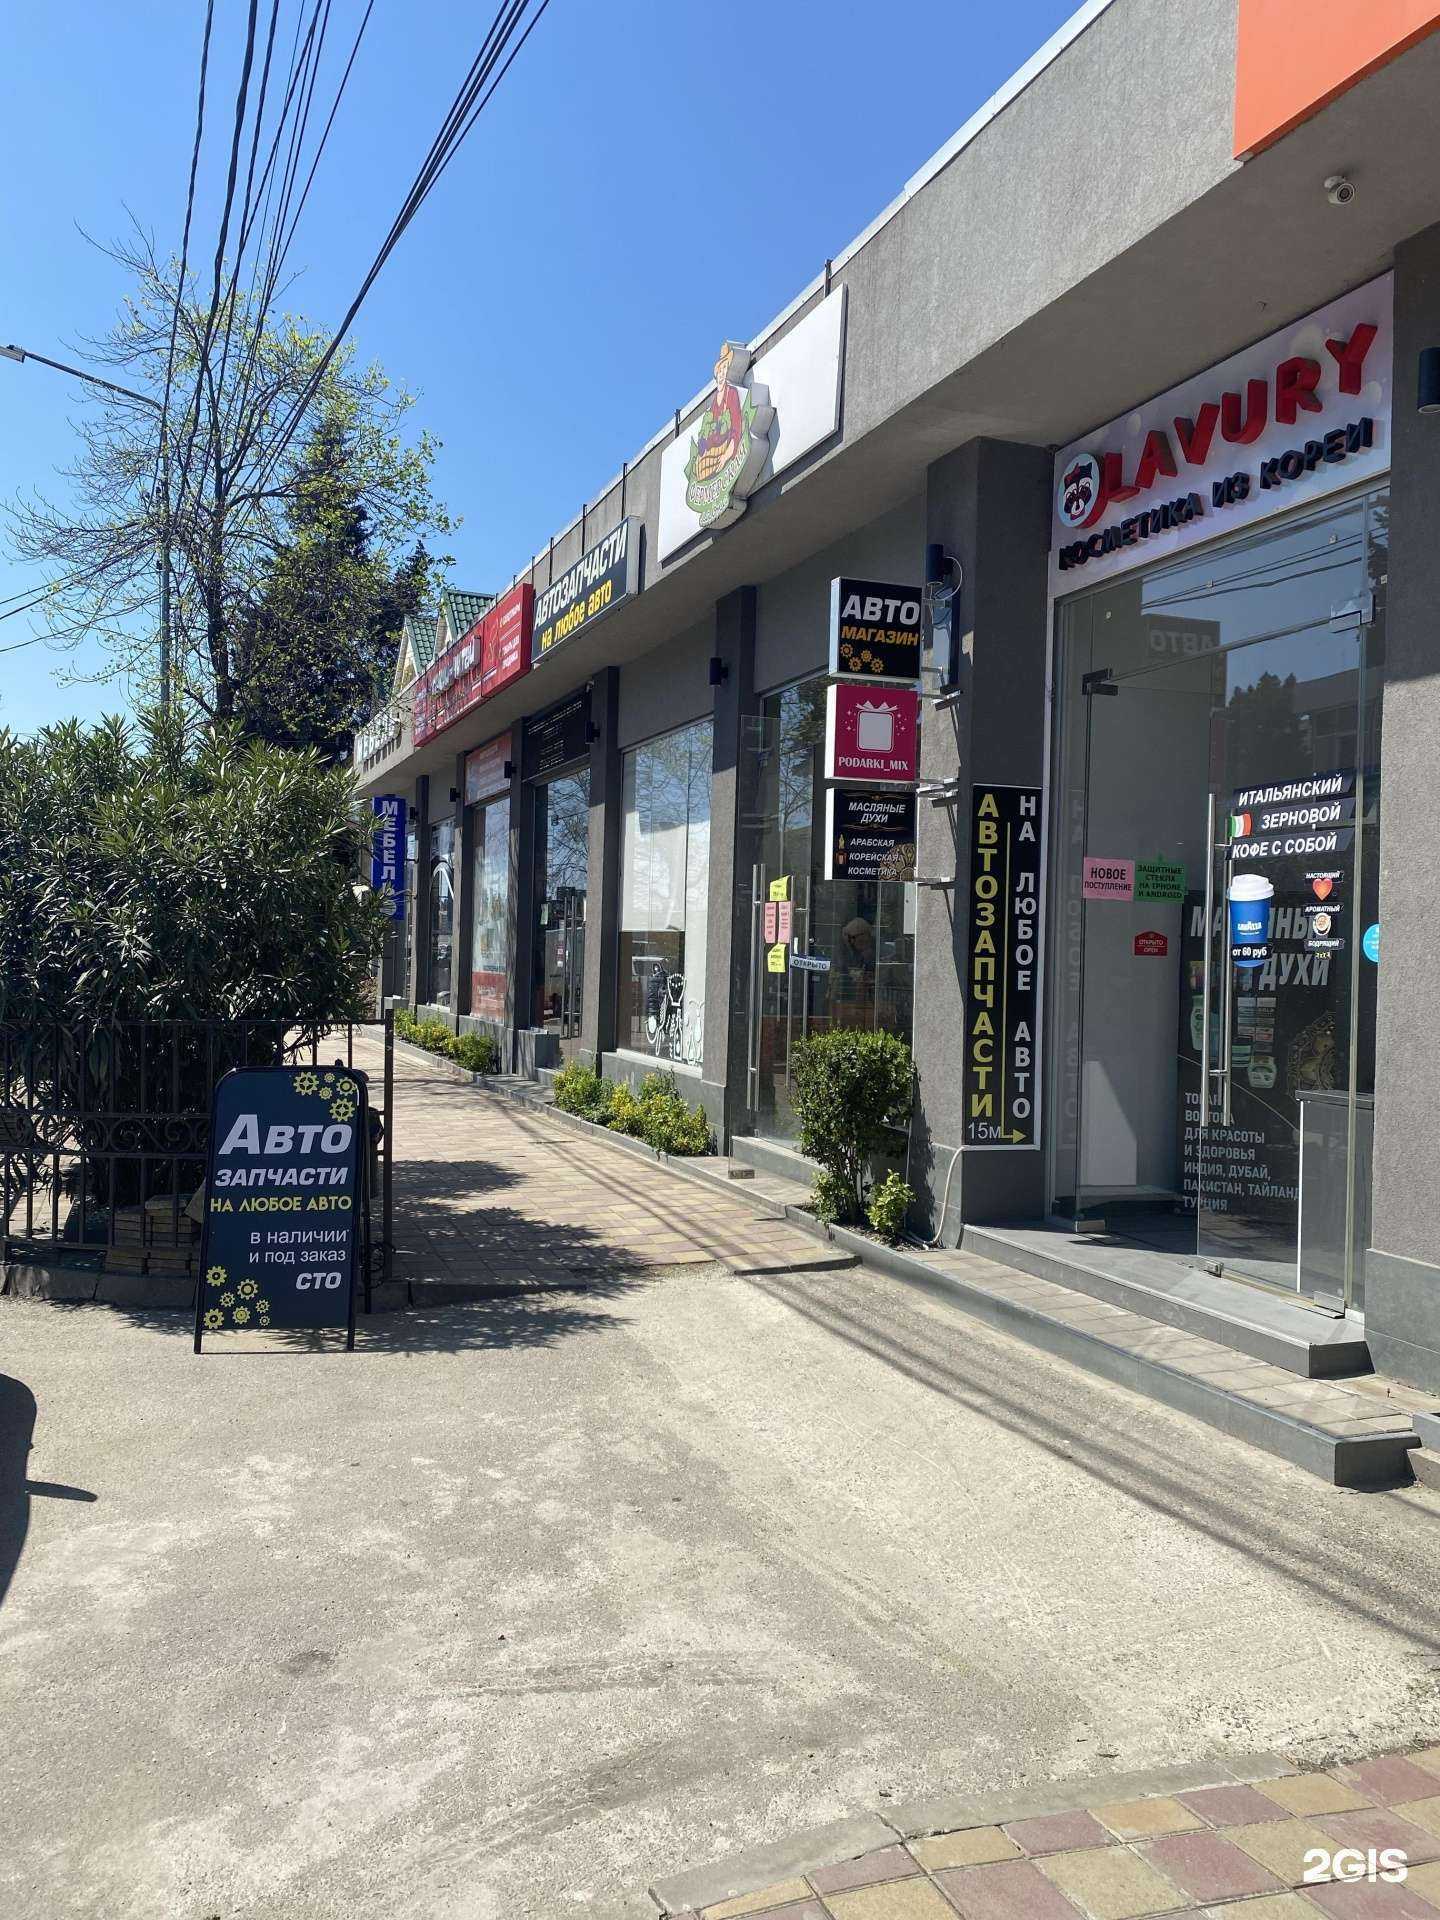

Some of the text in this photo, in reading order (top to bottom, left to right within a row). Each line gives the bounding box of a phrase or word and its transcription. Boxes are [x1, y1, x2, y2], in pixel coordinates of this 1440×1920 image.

[1101, 323, 1378, 502] LAVURY
[1059, 493, 1204, 571] КОСМЕТИКА
[1212, 472, 1250, 507] ИЗ
[534, 521, 629, 630] АВТОЗАПЧАСТИ
[541, 627, 553, 651] на
[554, 600, 586, 642] любое
[587, 579, 612, 616] авто
[841, 594, 921, 626] АВТО
[841, 626, 919, 646] МАГАЗИН
[838, 756, 909, 771] PODARKI_MIX
[1238, 773, 1343, 806] ИТАЛЬЯНСКИЙ
[848, 802, 906, 813] МАСЛЯНЫЕ
[1262, 801, 1341, 829] ЗЕРНОВОЙ
[860, 813, 889, 824] ДУХИ
[850, 838, 895, 847] АРАБСКАЯ
[1232, 831, 1338, 859] КОФЕ С СОБОЙ
[849, 851, 899, 861] КОРЕЙСКАЯ
[848, 867, 898, 876] КОСМЕТИКА
[1090, 867, 1126, 880] НОВОЕ
[1084, 881, 1132, 891] ПОСТУПЛЕНИЕ
[1305, 904, 1341, 913] АРОМАТНЫЙ
[971, 793, 999, 1117] АВТОЗАПЧАСТИ
[1012, 796, 1037, 1119] НА ЛЮБОЕ АВТО
[1232, 949, 1241, 957] от
[1252, 947, 1268, 958] руб
[793, 959, 827, 969] ОТКРЫТО
[1259, 953, 1330, 991] ДУХИ
[1184, 1127, 1265, 1144] ДЛЯ КРАСОТЫ
[1184, 1144, 1256, 1160] И ЗДОРОВЬЯ
[215, 1167, 348, 1187] ЗАПЧАСТИ
[1184, 1162, 1271, 1181] ИНДИЯ, ДУБАЙ,
[210, 1196, 352, 1213] НА ЛЮБОЕ АВТО
[250, 1229, 348, 1244] в наличии
[249, 1250, 346, 1265] и под заказ
[295, 1272, 342, 1290] СТО
